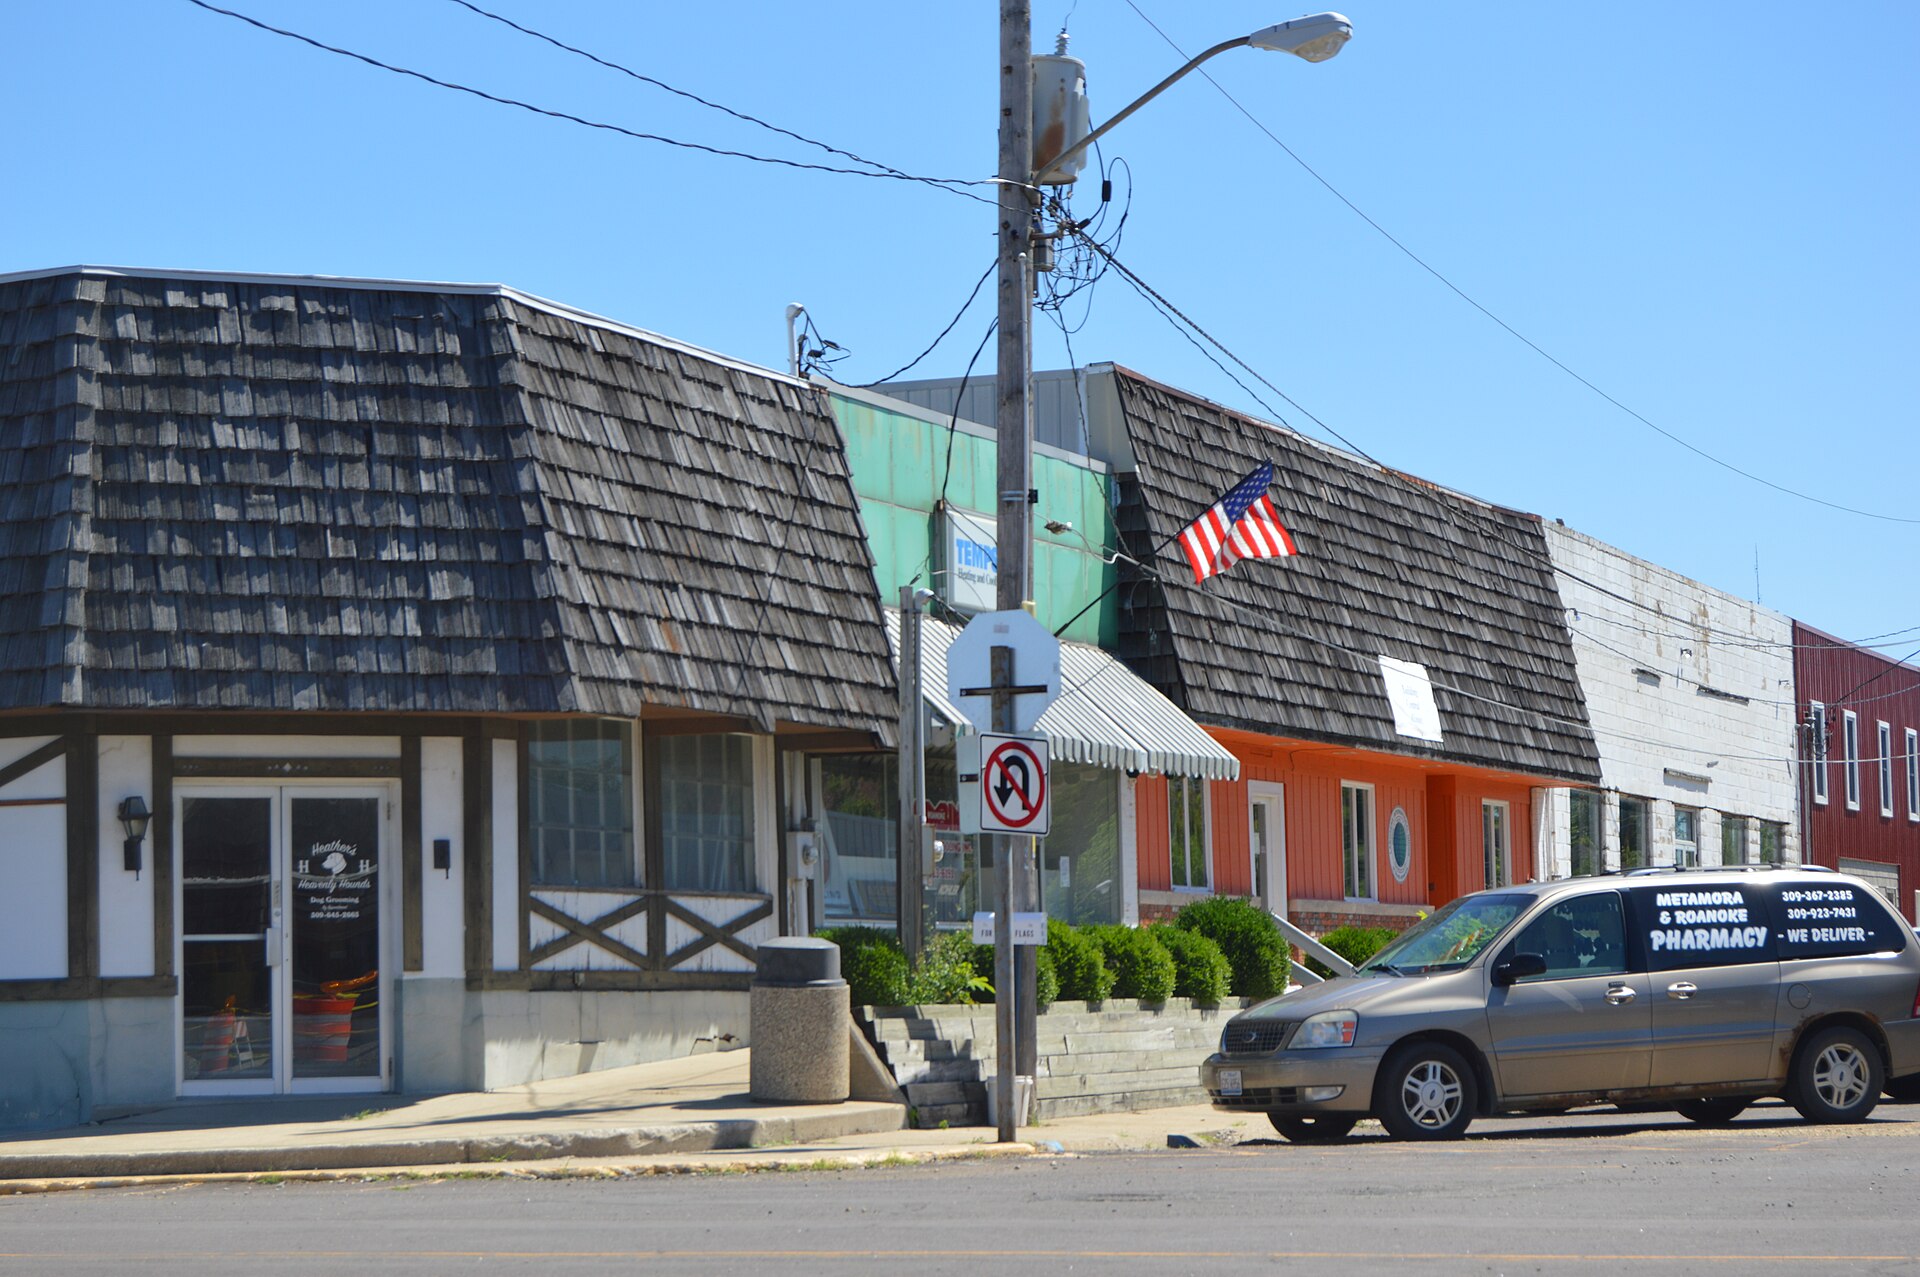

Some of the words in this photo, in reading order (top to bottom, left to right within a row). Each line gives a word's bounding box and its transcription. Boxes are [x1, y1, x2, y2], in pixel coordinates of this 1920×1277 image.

[312, 839, 357, 856] Heather's
[299, 860, 309, 873] H
[360, 860, 370, 873] H
[298, 879, 337, 893] Heavenly
[339, 879, 370, 889] Hounds
[310, 896, 324, 904] Dog
[326, 896, 360, 904] Grooming
[1656, 891, 1744, 906] METAMORA
[1782, 890, 1853, 902] 309-367-2385
[1659, 911, 1671, 925] &
[1675, 908, 1748, 925] ROANOKE
[1787, 907, 1856, 919] 309-923-7431
[981, 929, 992, 937] FOR
[1015, 929, 1034, 937] FLAGS
[1650, 926, 1767, 951] PHARMACY
[1787, 928, 1808, 943] WE
[1811, 927, 1866, 942] DELIVER
